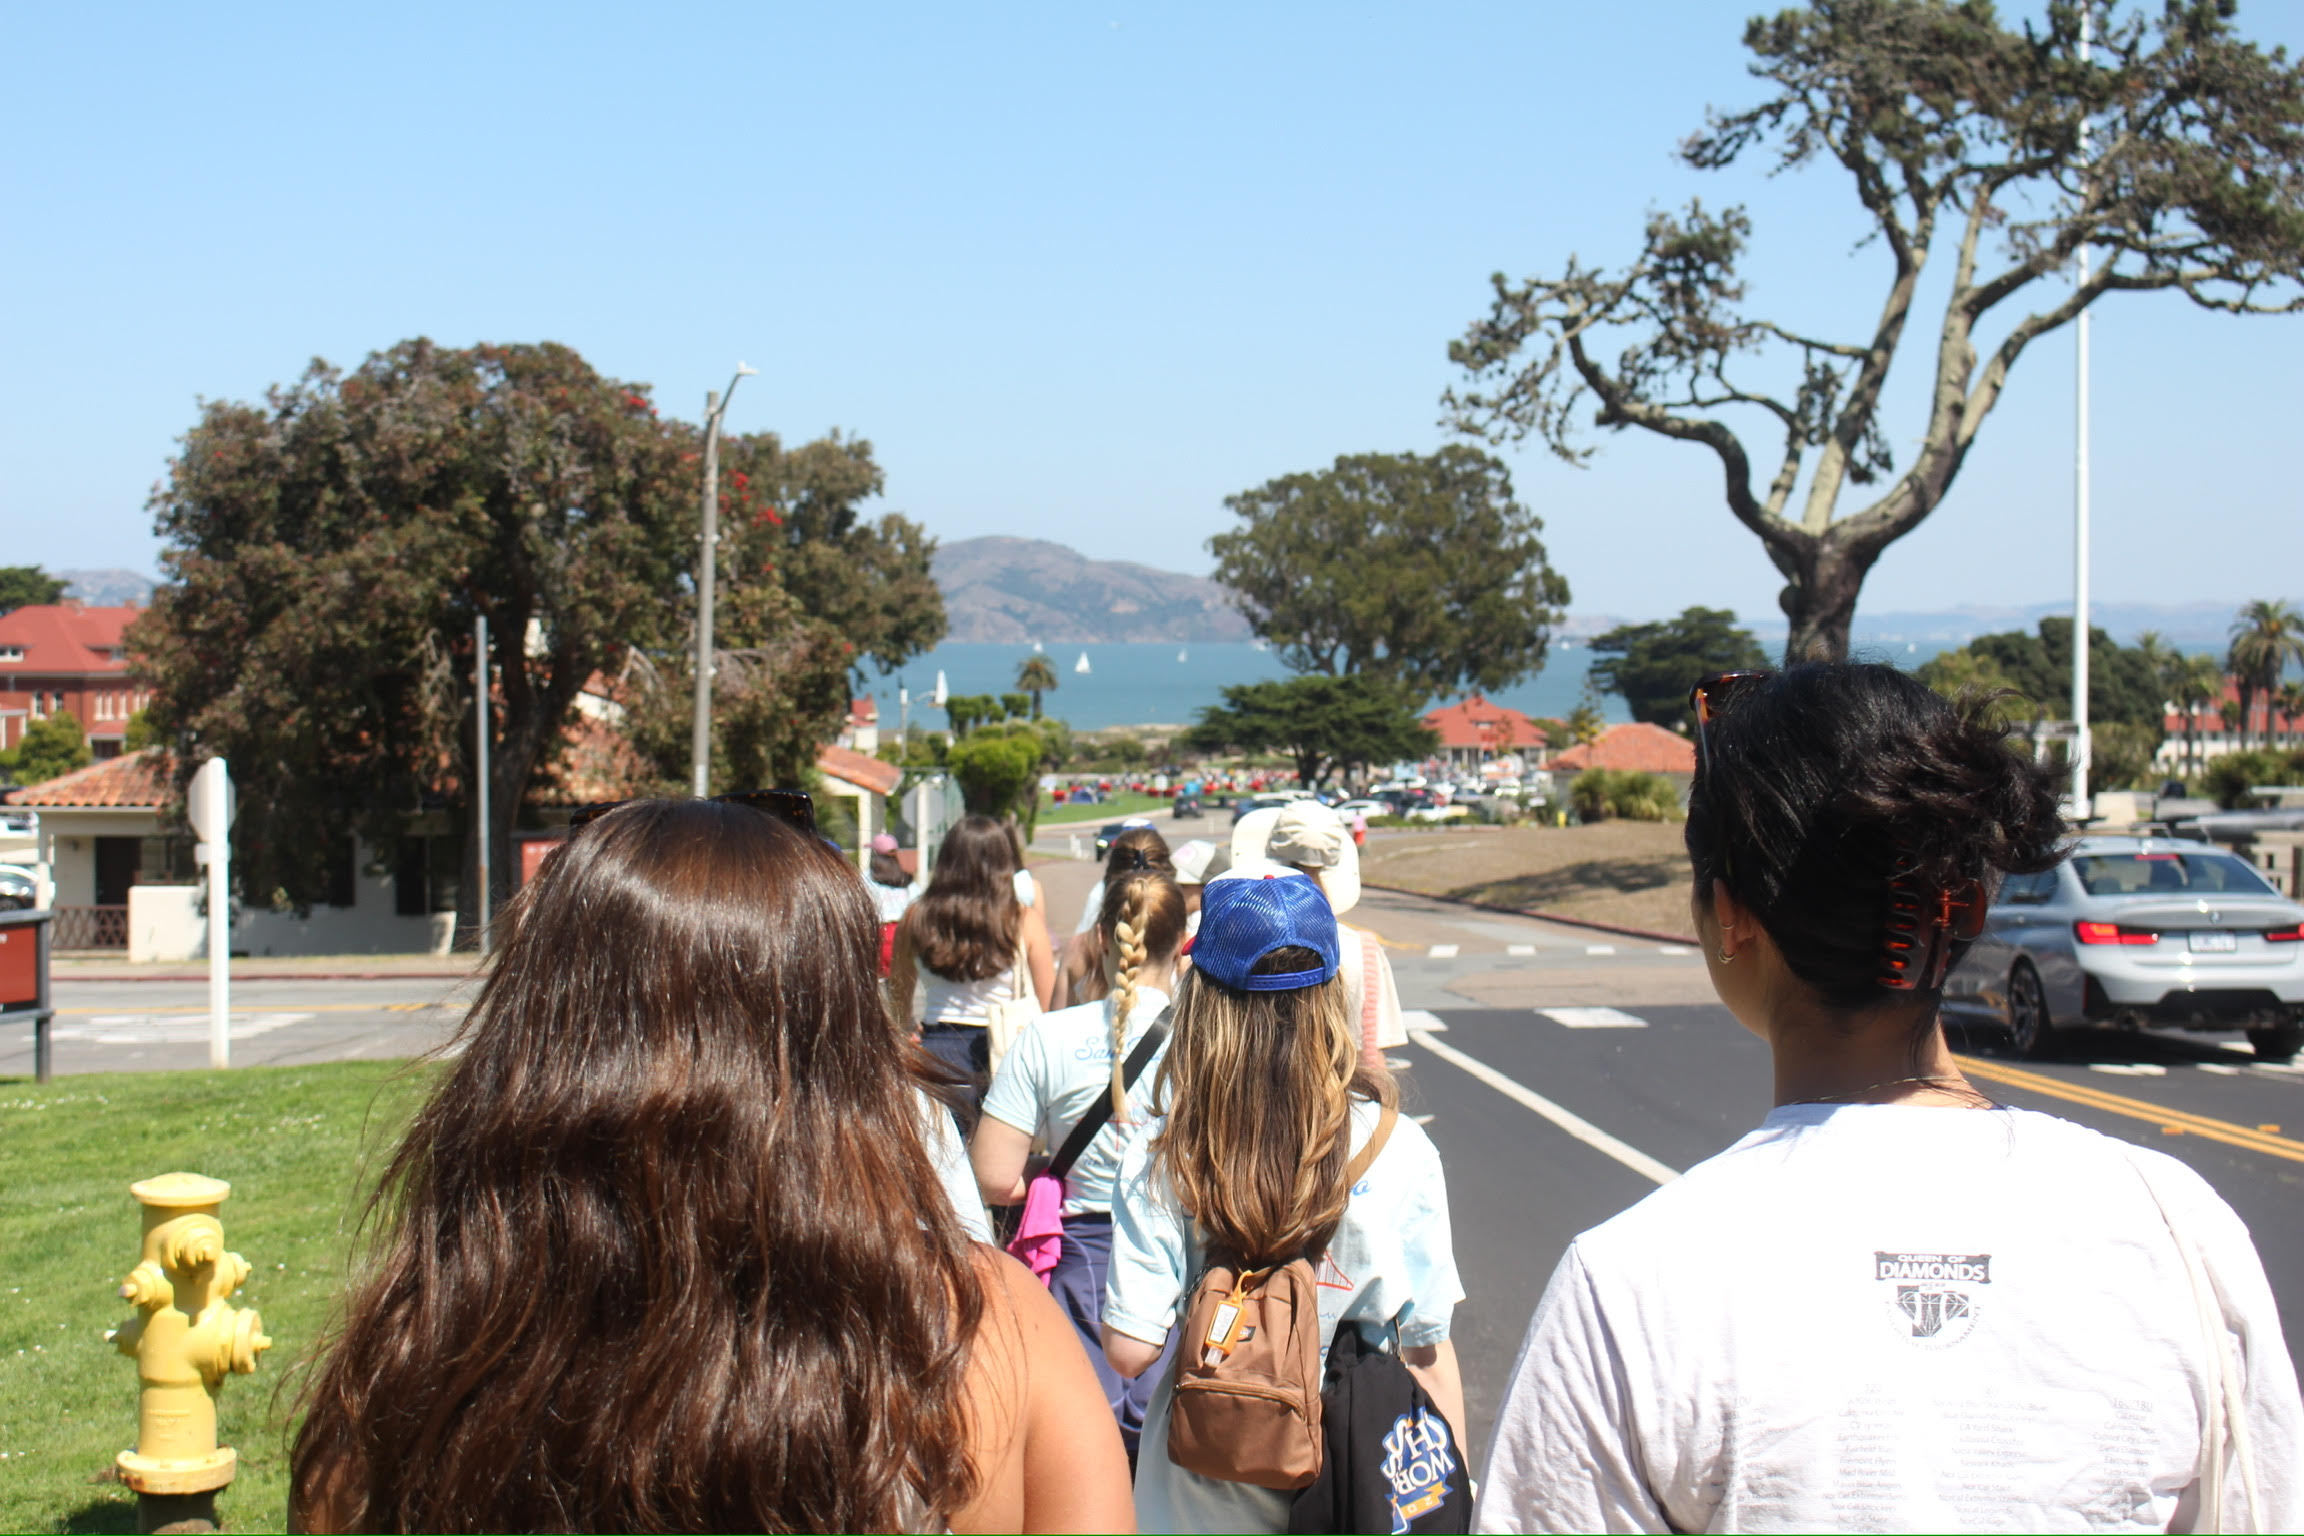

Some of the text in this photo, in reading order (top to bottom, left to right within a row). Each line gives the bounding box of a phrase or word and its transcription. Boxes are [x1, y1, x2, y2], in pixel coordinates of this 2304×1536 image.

[1897, 1254, 1967, 1264] QUEEN OF
[1879, 1261, 1986, 1281] DIAMONDS
